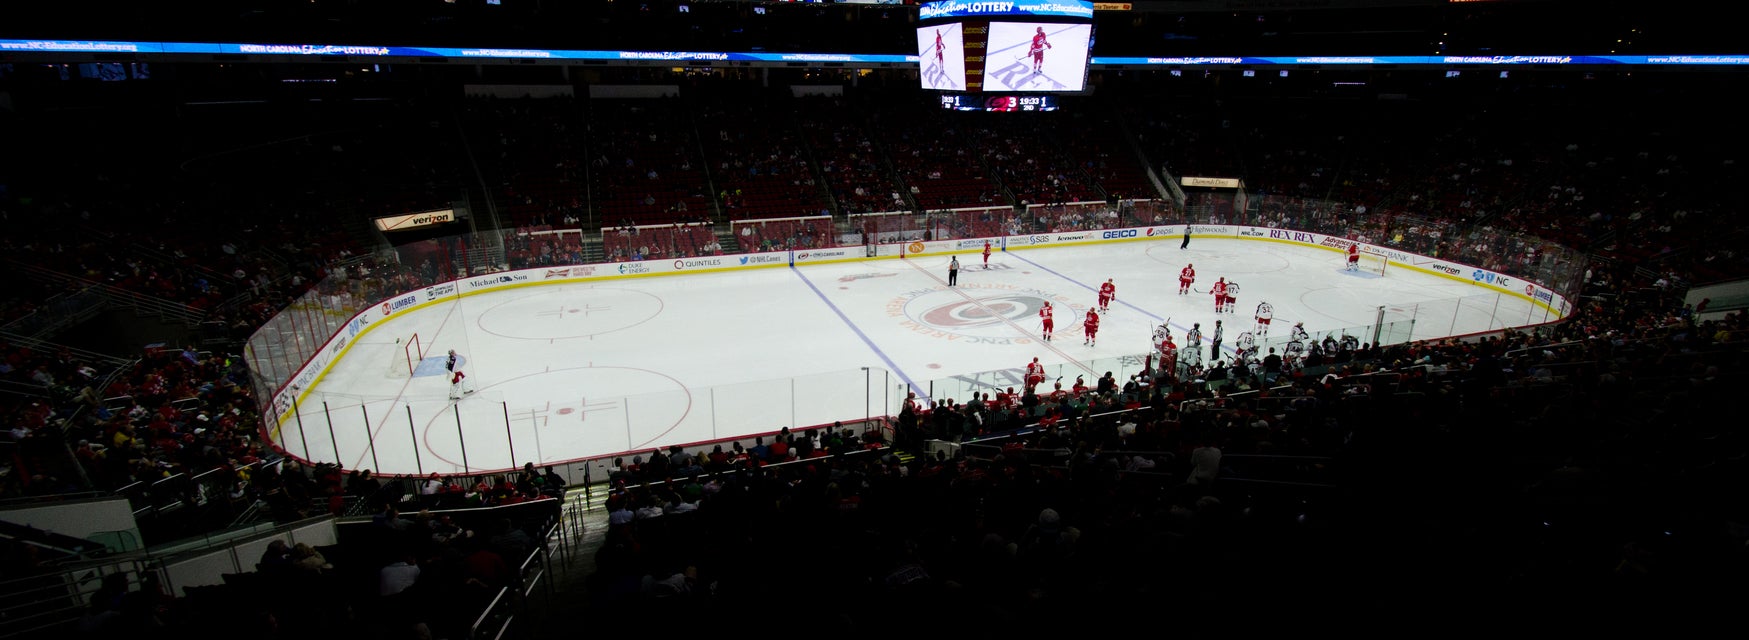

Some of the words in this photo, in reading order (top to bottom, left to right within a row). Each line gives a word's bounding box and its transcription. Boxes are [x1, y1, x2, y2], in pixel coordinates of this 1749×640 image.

[968, 2, 1014, 12] LOTTERY
[266, 45, 302, 54] CAROLINA
[954, 96, 960, 106] 1
[1008, 97, 1017, 107] 3
[1041, 97, 1046, 107] 1
[413, 214, 448, 224] verizon
[1103, 229, 1137, 239] GEICO
[1155, 227, 1174, 236] pepsi
[1270, 229, 1291, 240] REX
[1294, 232, 1316, 243] REX
[1432, 263, 1460, 274] verizon
[470, 278, 499, 288] Michael
[1496, 276, 1510, 286] NC
[392, 296, 416, 310] LUMBER
[1262, 306, 1270, 314] 32
[360, 314, 368, 326] NC
[1244, 336, 1252, 344] 13
